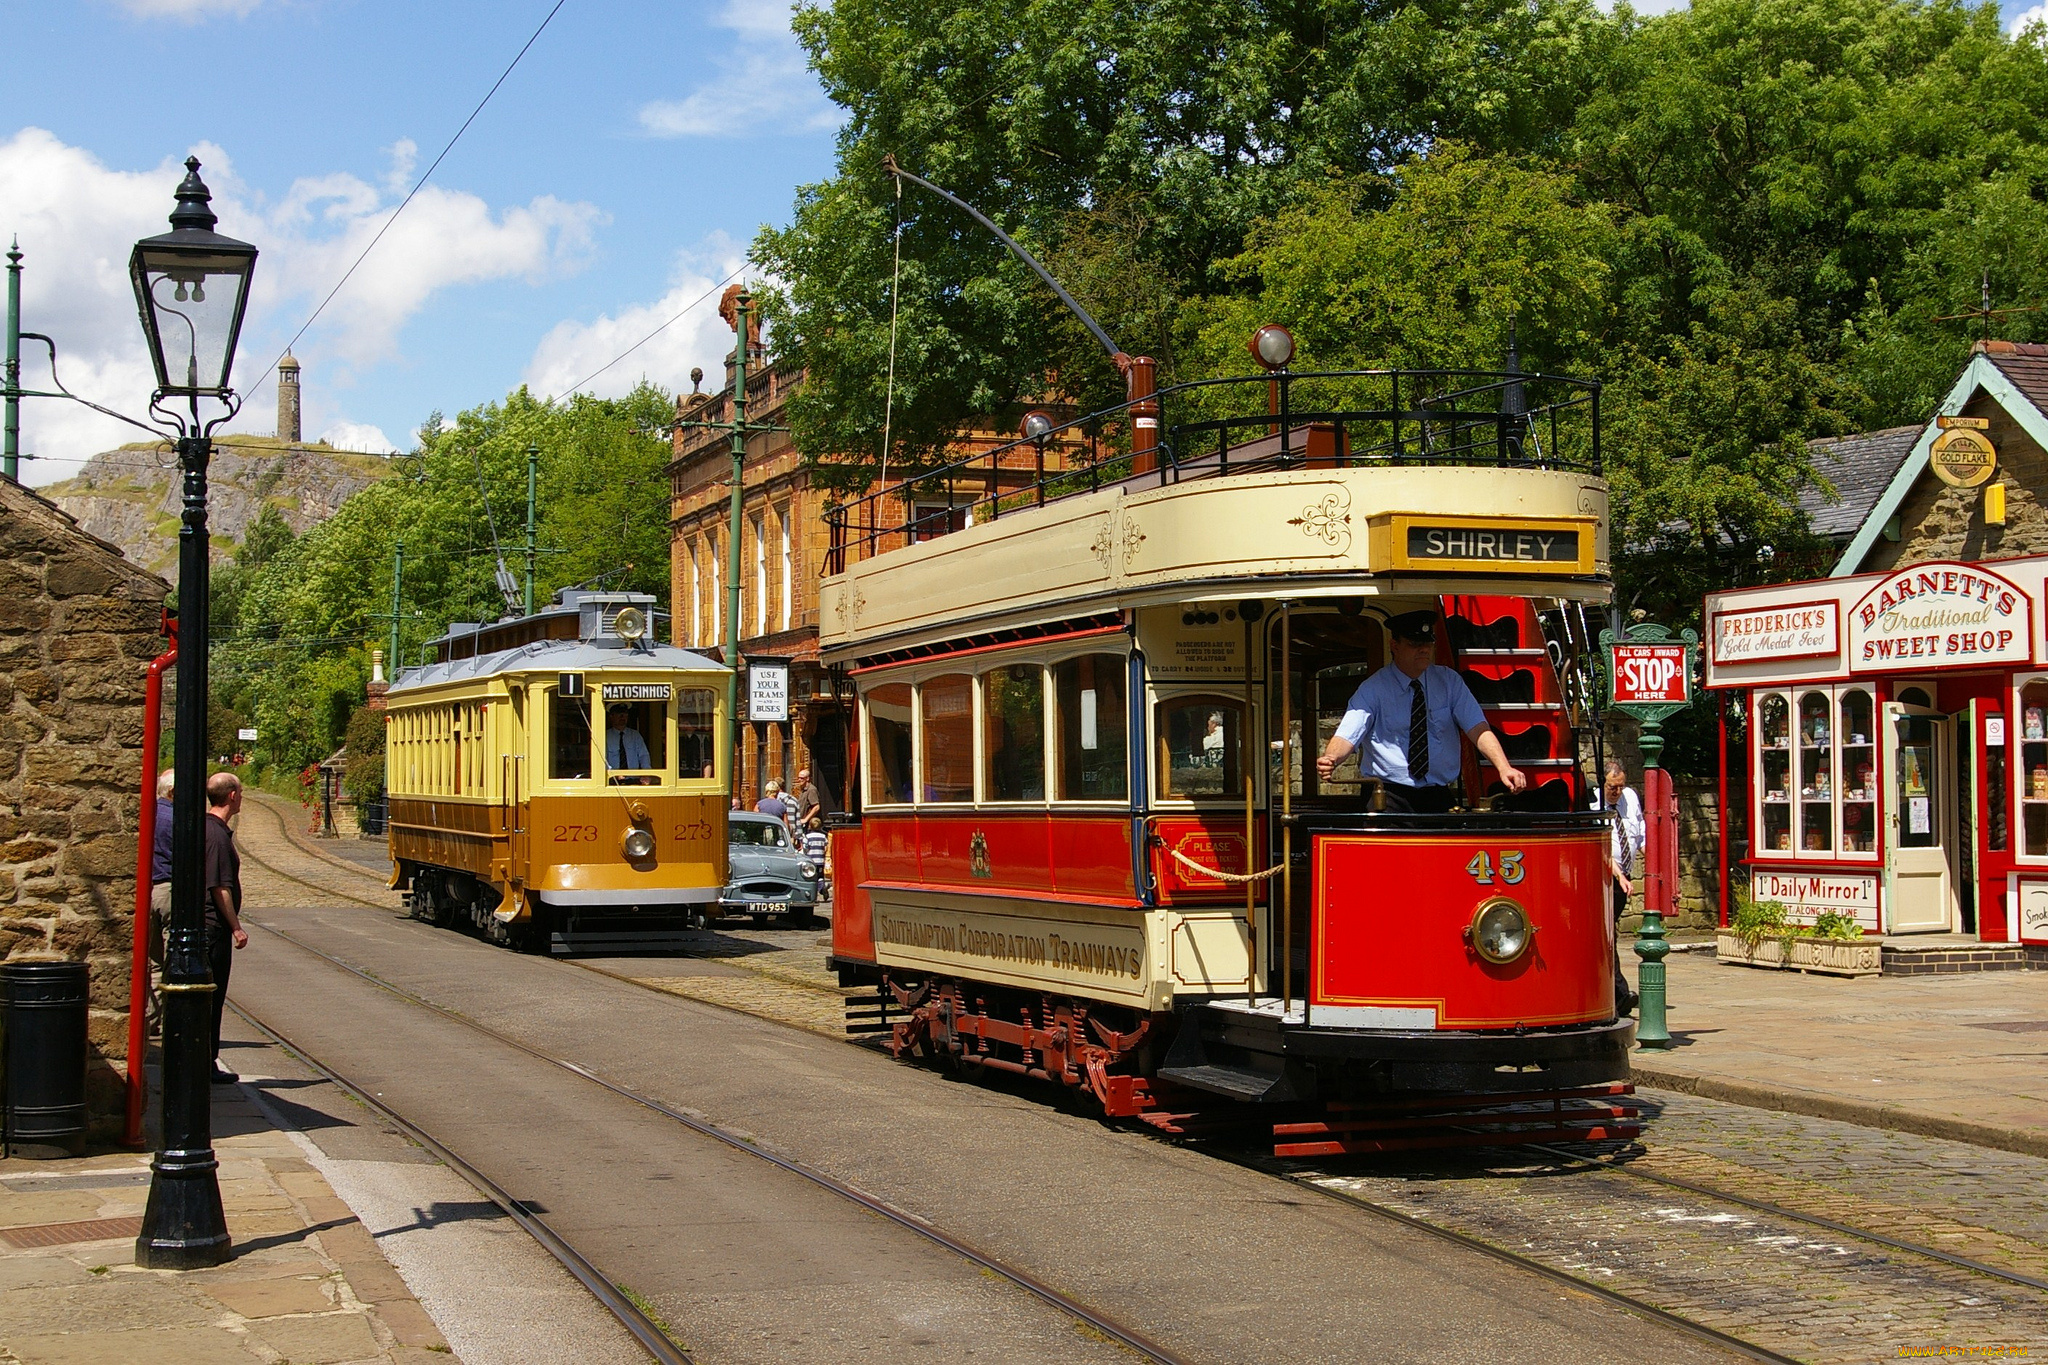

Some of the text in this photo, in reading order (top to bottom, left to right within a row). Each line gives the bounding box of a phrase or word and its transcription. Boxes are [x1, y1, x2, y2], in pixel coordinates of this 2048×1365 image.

[1945, 418, 1981, 426] EMPORIUM
[1939, 452, 1988, 464] GOLD FLAKE
[1426, 529, 1555, 560] SHIRLEY
[1860, 570, 2018, 633] BARNETT'S
[1722, 609, 1825, 637] FREDERICK'S
[1882, 602, 1993, 634] Traditional
[1618, 649, 1680, 657] ALL CARS INWARD
[1723, 631, 1825, 659] Gold Medal Ices
[1863, 628, 2014, 662] SWEET SHOP
[760, 671, 778, 679] USE
[1623, 658, 1676, 691] STOP
[602, 685, 671, 699] MATOSINHOS
[756, 680, 780, 689] YOUR
[751, 690, 785, 699] TRAMS
[1634, 691, 1667, 700] HERE
[756, 705, 781, 713] BUSES
[553, 824, 598, 842] 273
[674, 823, 713, 841] 273
[1193, 842, 1231, 852] PLEASE
[1464, 849, 1526, 885] 45
[1771, 876, 1807, 902] Daily
[1809, 877, 1860, 900] Mirror
[1795, 905, 1821, 916] ALONG
